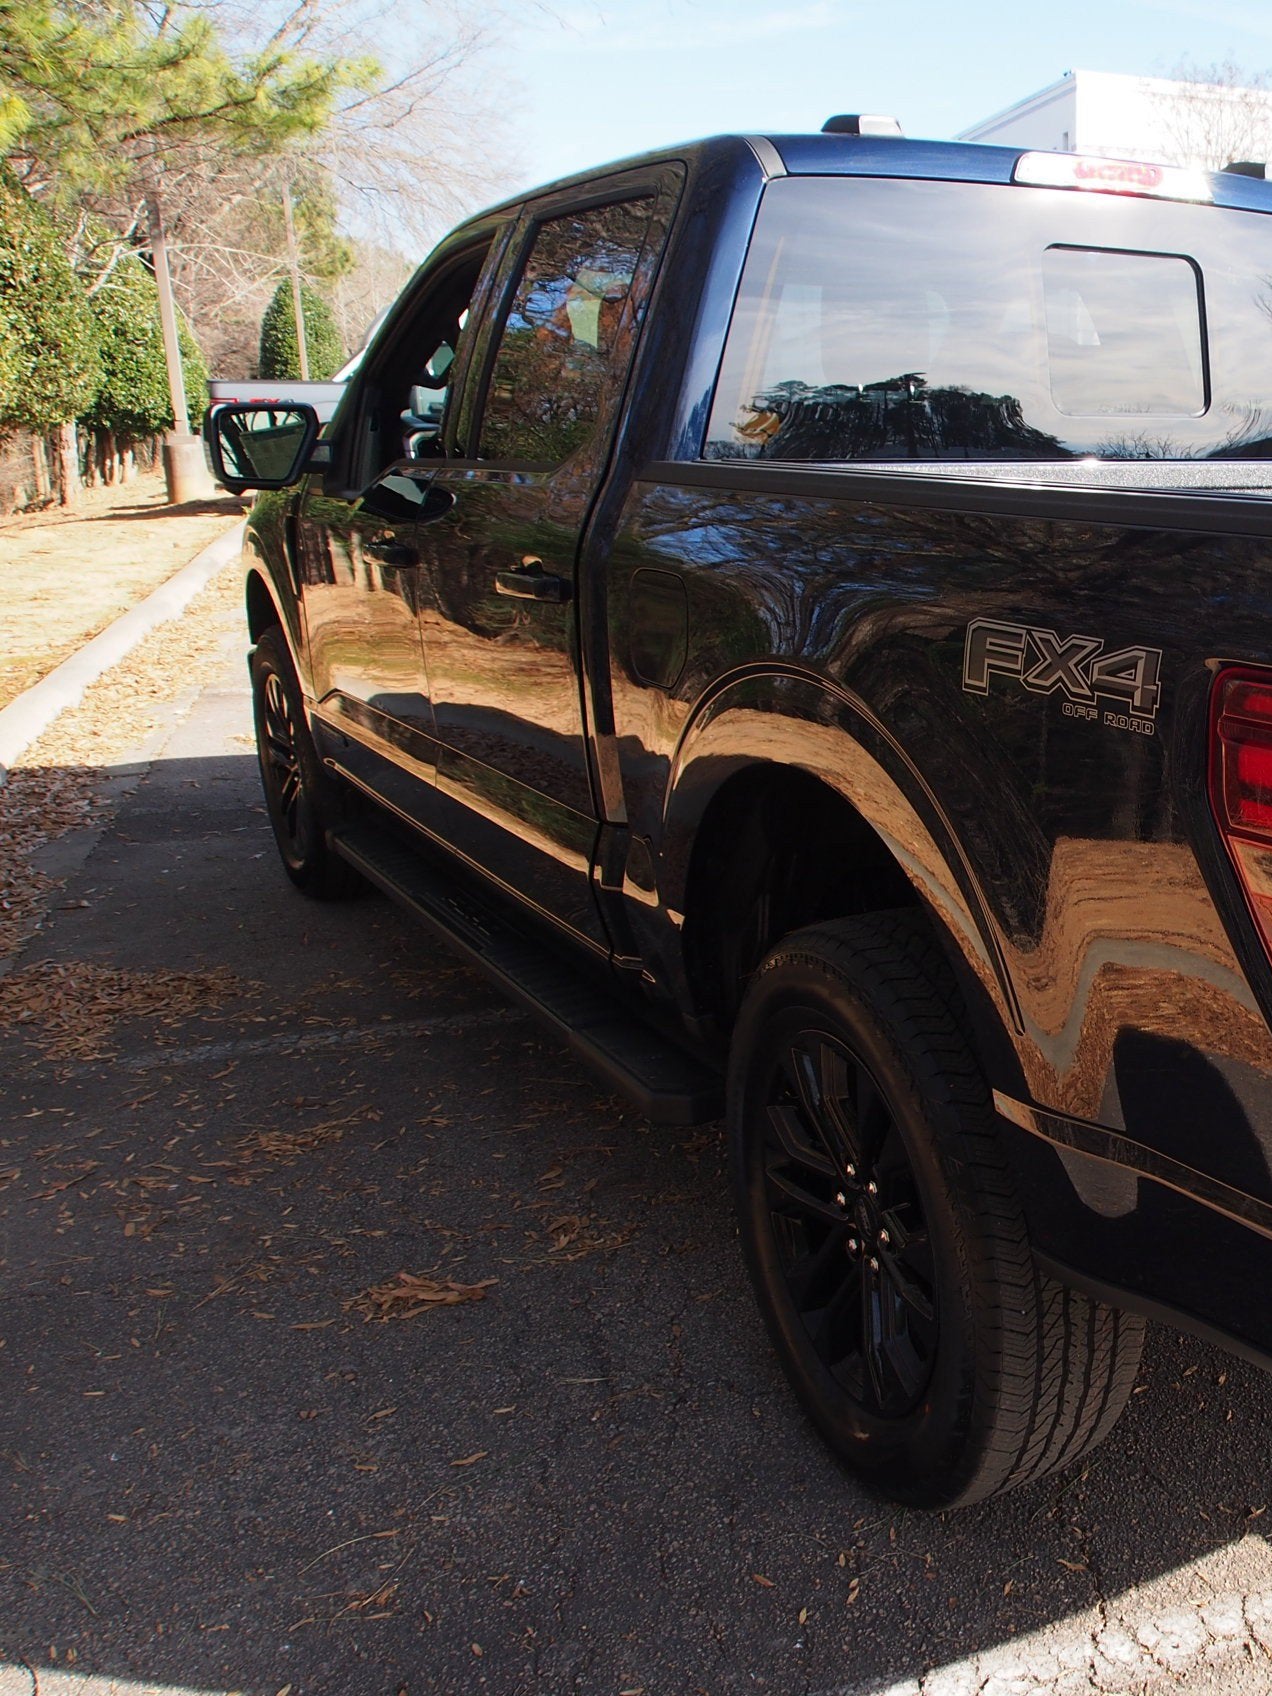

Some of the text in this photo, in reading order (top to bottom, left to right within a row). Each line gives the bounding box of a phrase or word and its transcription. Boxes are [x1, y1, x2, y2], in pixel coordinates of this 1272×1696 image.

[961, 616, 1163, 719] FX4
[1062, 702, 1156, 736] OFF ROAD
